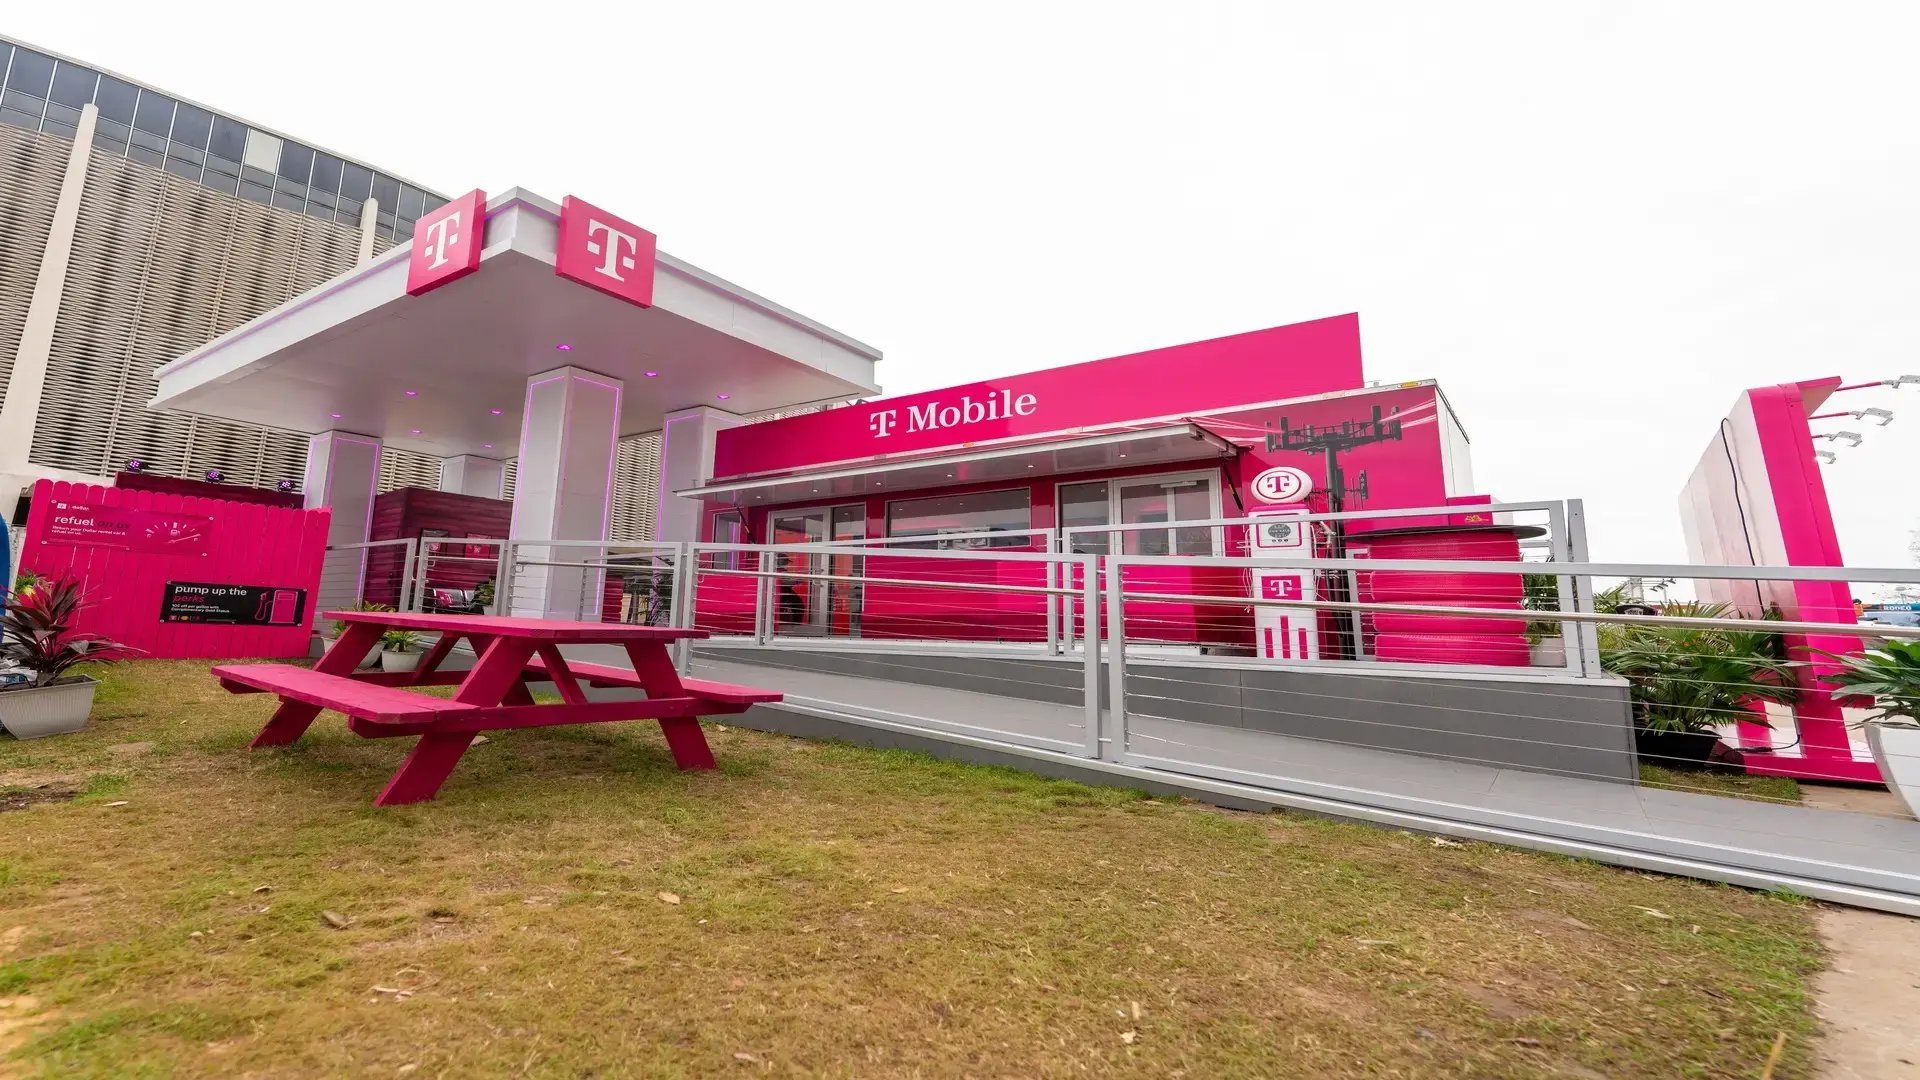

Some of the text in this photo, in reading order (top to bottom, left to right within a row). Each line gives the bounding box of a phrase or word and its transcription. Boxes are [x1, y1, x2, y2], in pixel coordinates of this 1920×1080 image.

[424, 211, 460, 270] T
[587, 218, 637, 282] T
[869, 389, 1037, 438] T Mobile
[1266, 475, 1290, 493] T
[54, 516, 94, 526] refuel
[175, 586, 247, 596] pump up the
[1270, 579, 1292, 597] T
[173, 594, 206, 603] perks
